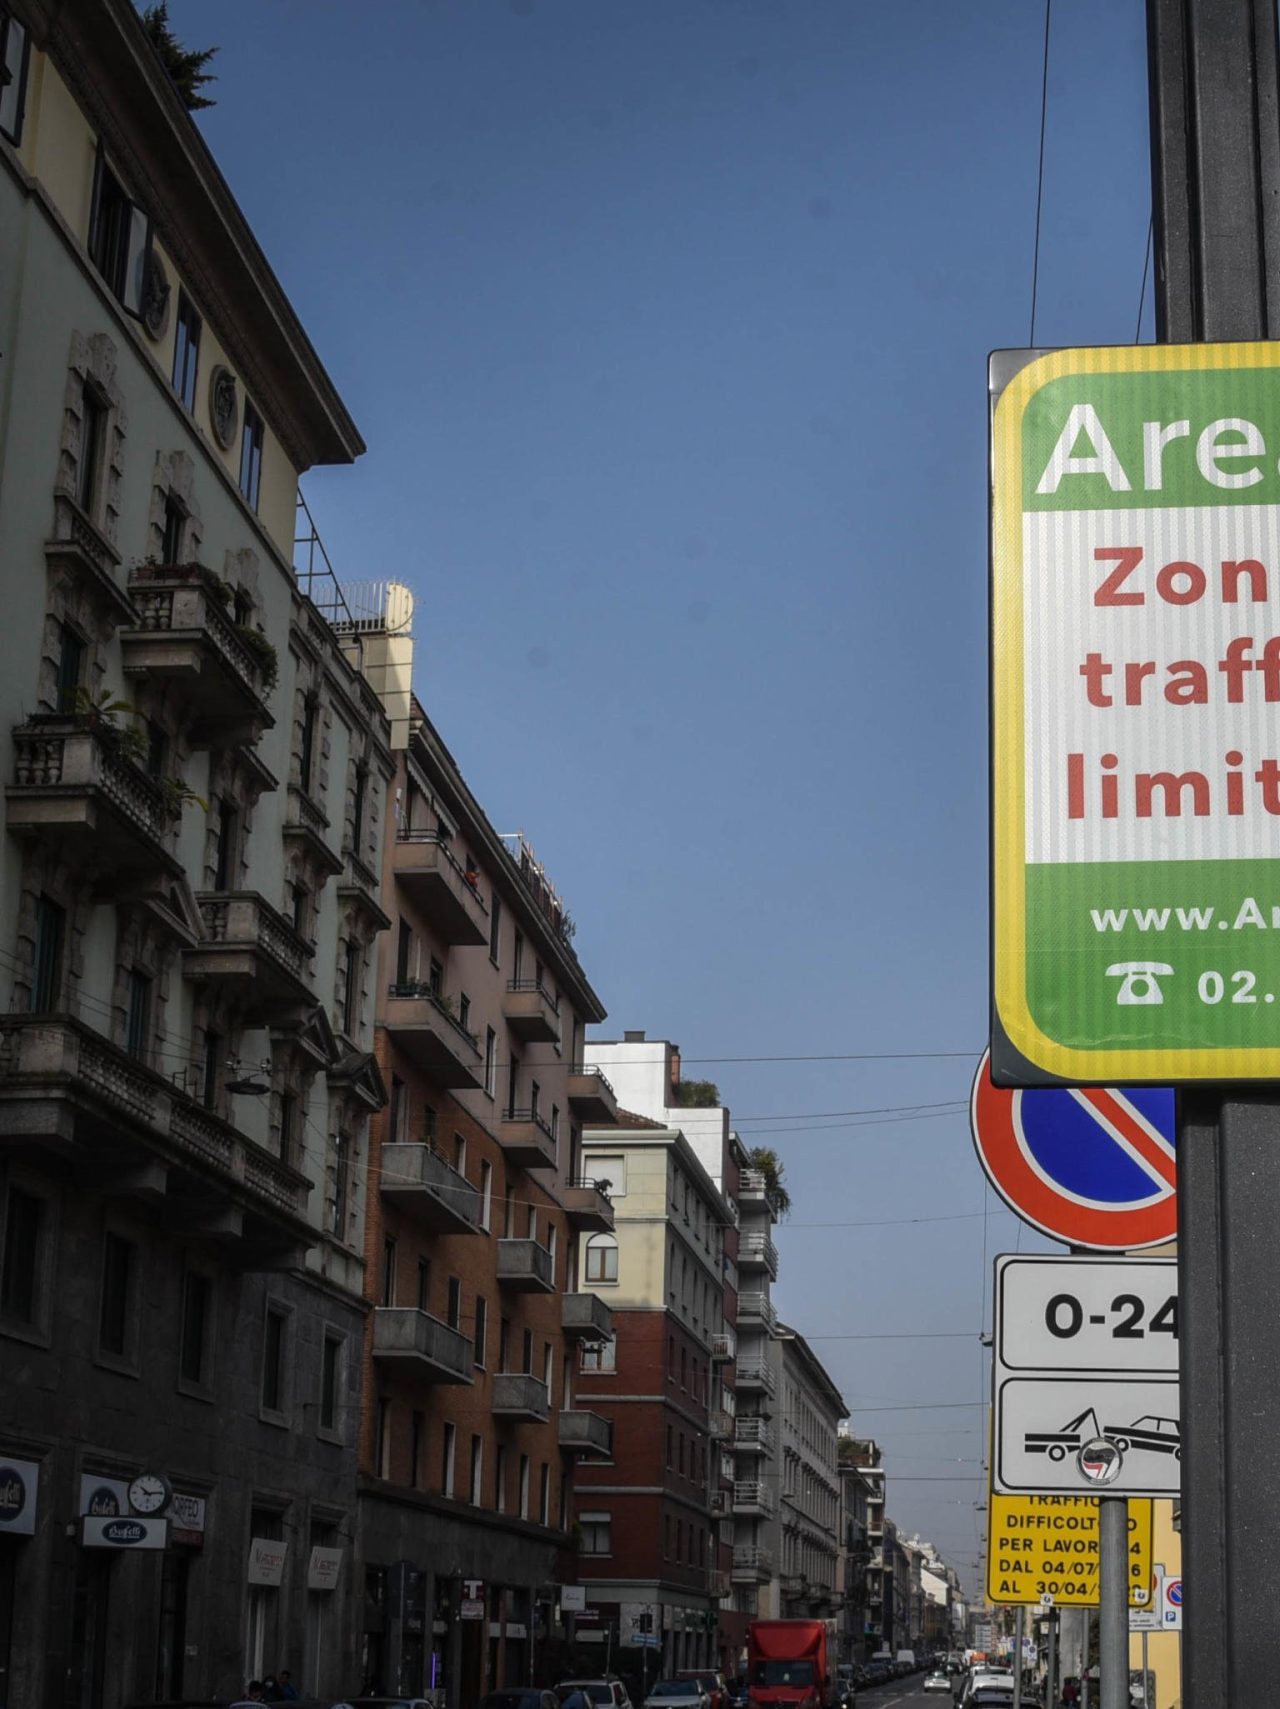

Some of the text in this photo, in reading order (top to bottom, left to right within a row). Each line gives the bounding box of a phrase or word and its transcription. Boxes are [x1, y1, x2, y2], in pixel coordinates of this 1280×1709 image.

[1045, 1294, 1179, 1339] 0-24
[1029, 1496, 1100, 1508] TRAFFIC
[999, 1538, 1033, 1552] PER
[999, 1560, 1034, 1574] DAL
[999, 1581, 1022, 1594] AL
